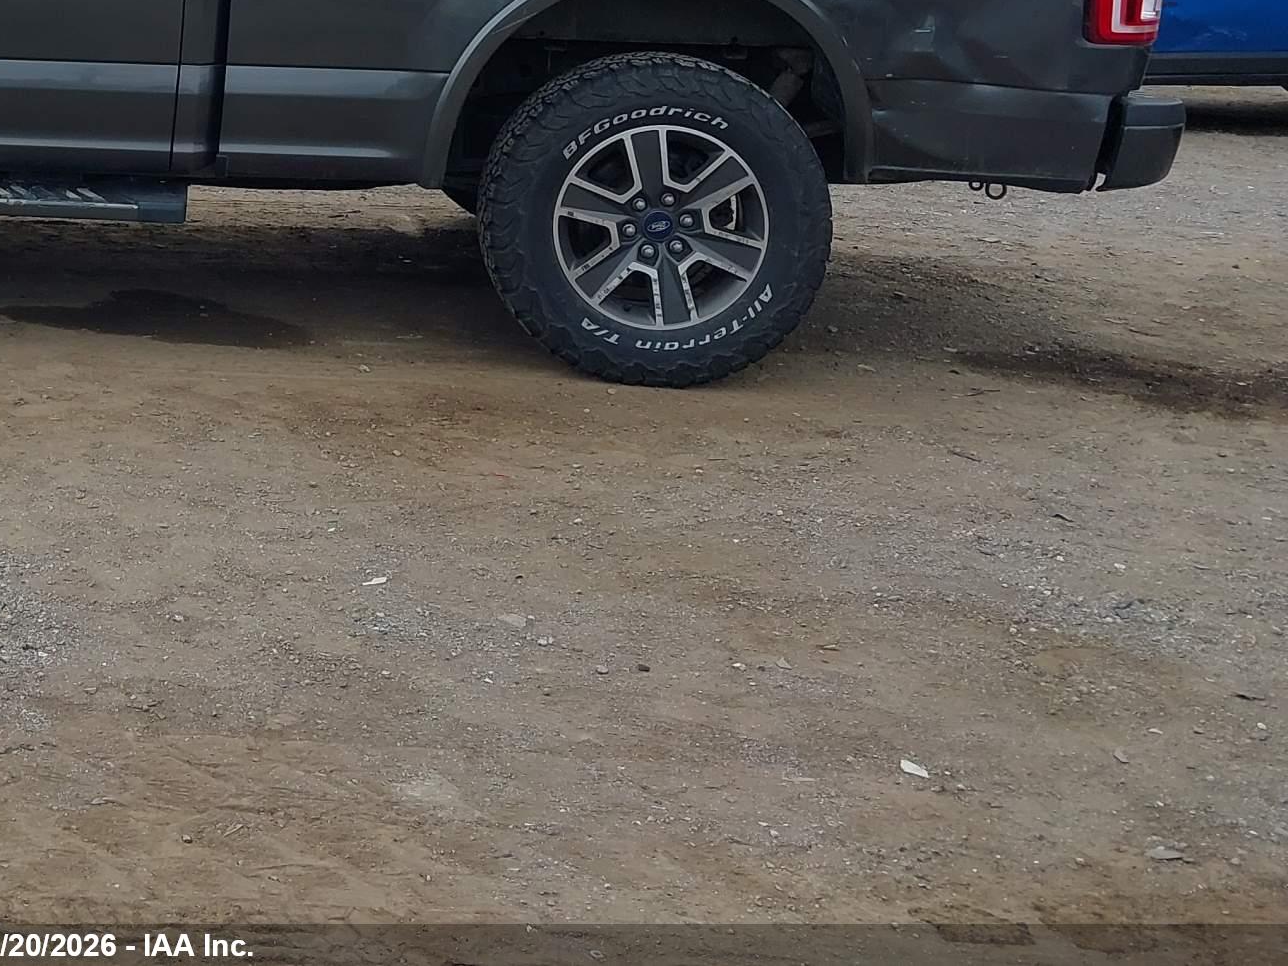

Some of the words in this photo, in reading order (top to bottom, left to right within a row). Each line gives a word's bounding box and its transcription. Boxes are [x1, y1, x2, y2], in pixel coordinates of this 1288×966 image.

[563, 106, 729, 160] BFGoodrich
[579, 317, 623, 344] T/A
[635, 282, 775, 353] All-Terrain
